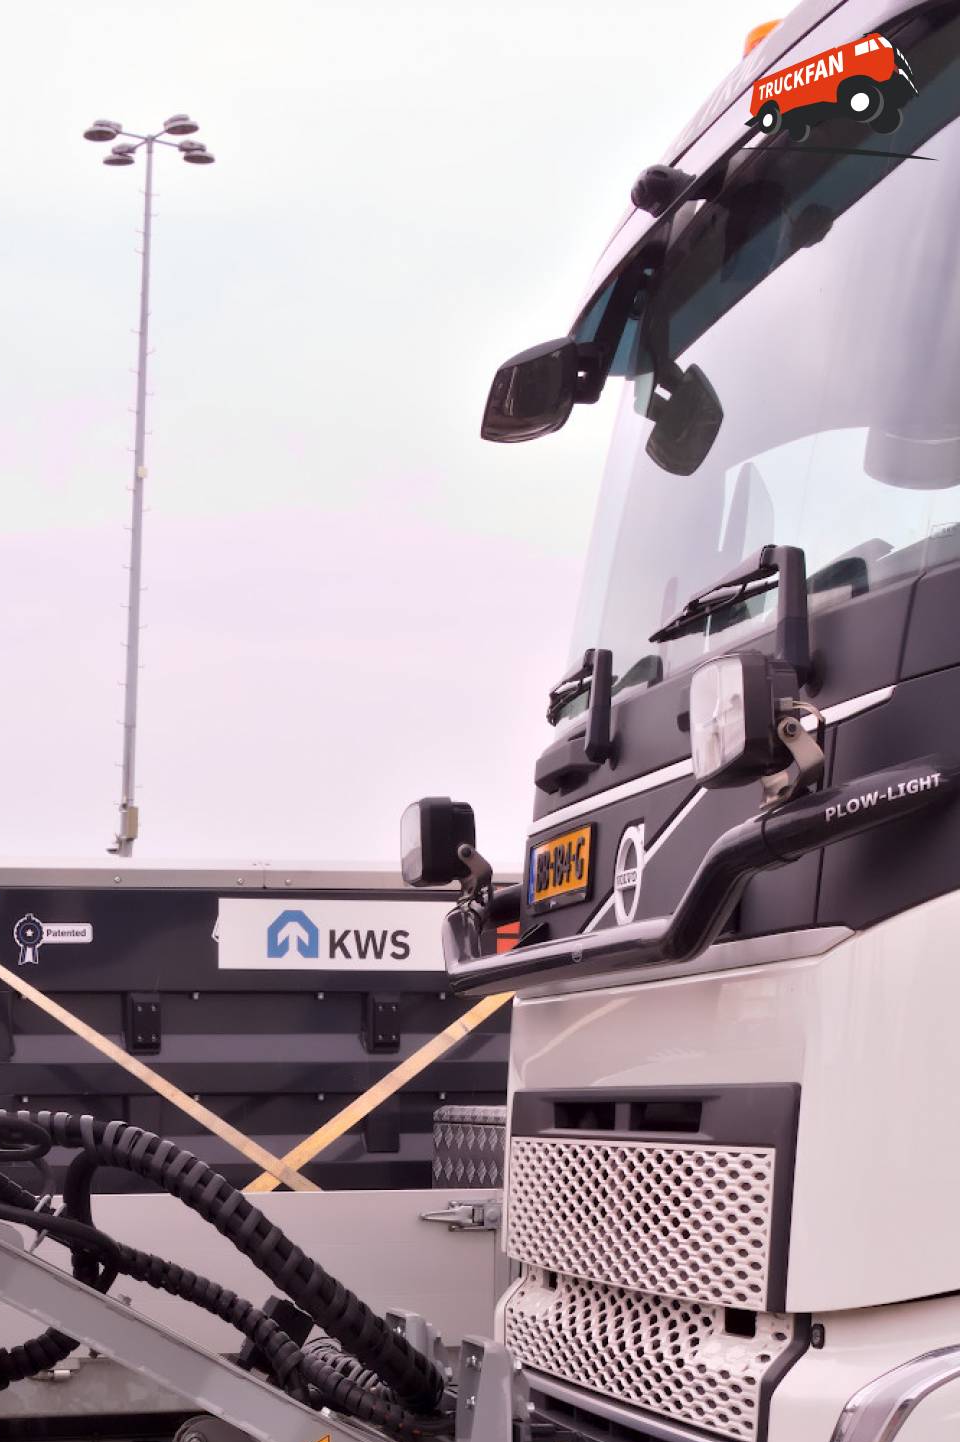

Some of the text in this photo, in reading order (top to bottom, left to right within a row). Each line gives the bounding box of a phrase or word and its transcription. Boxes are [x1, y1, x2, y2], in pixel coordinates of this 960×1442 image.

[825, 772, 942, 822] PLOW-LIGHT
[46, 928, 87, 938] Patented
[328, 929, 411, 960] KWS
